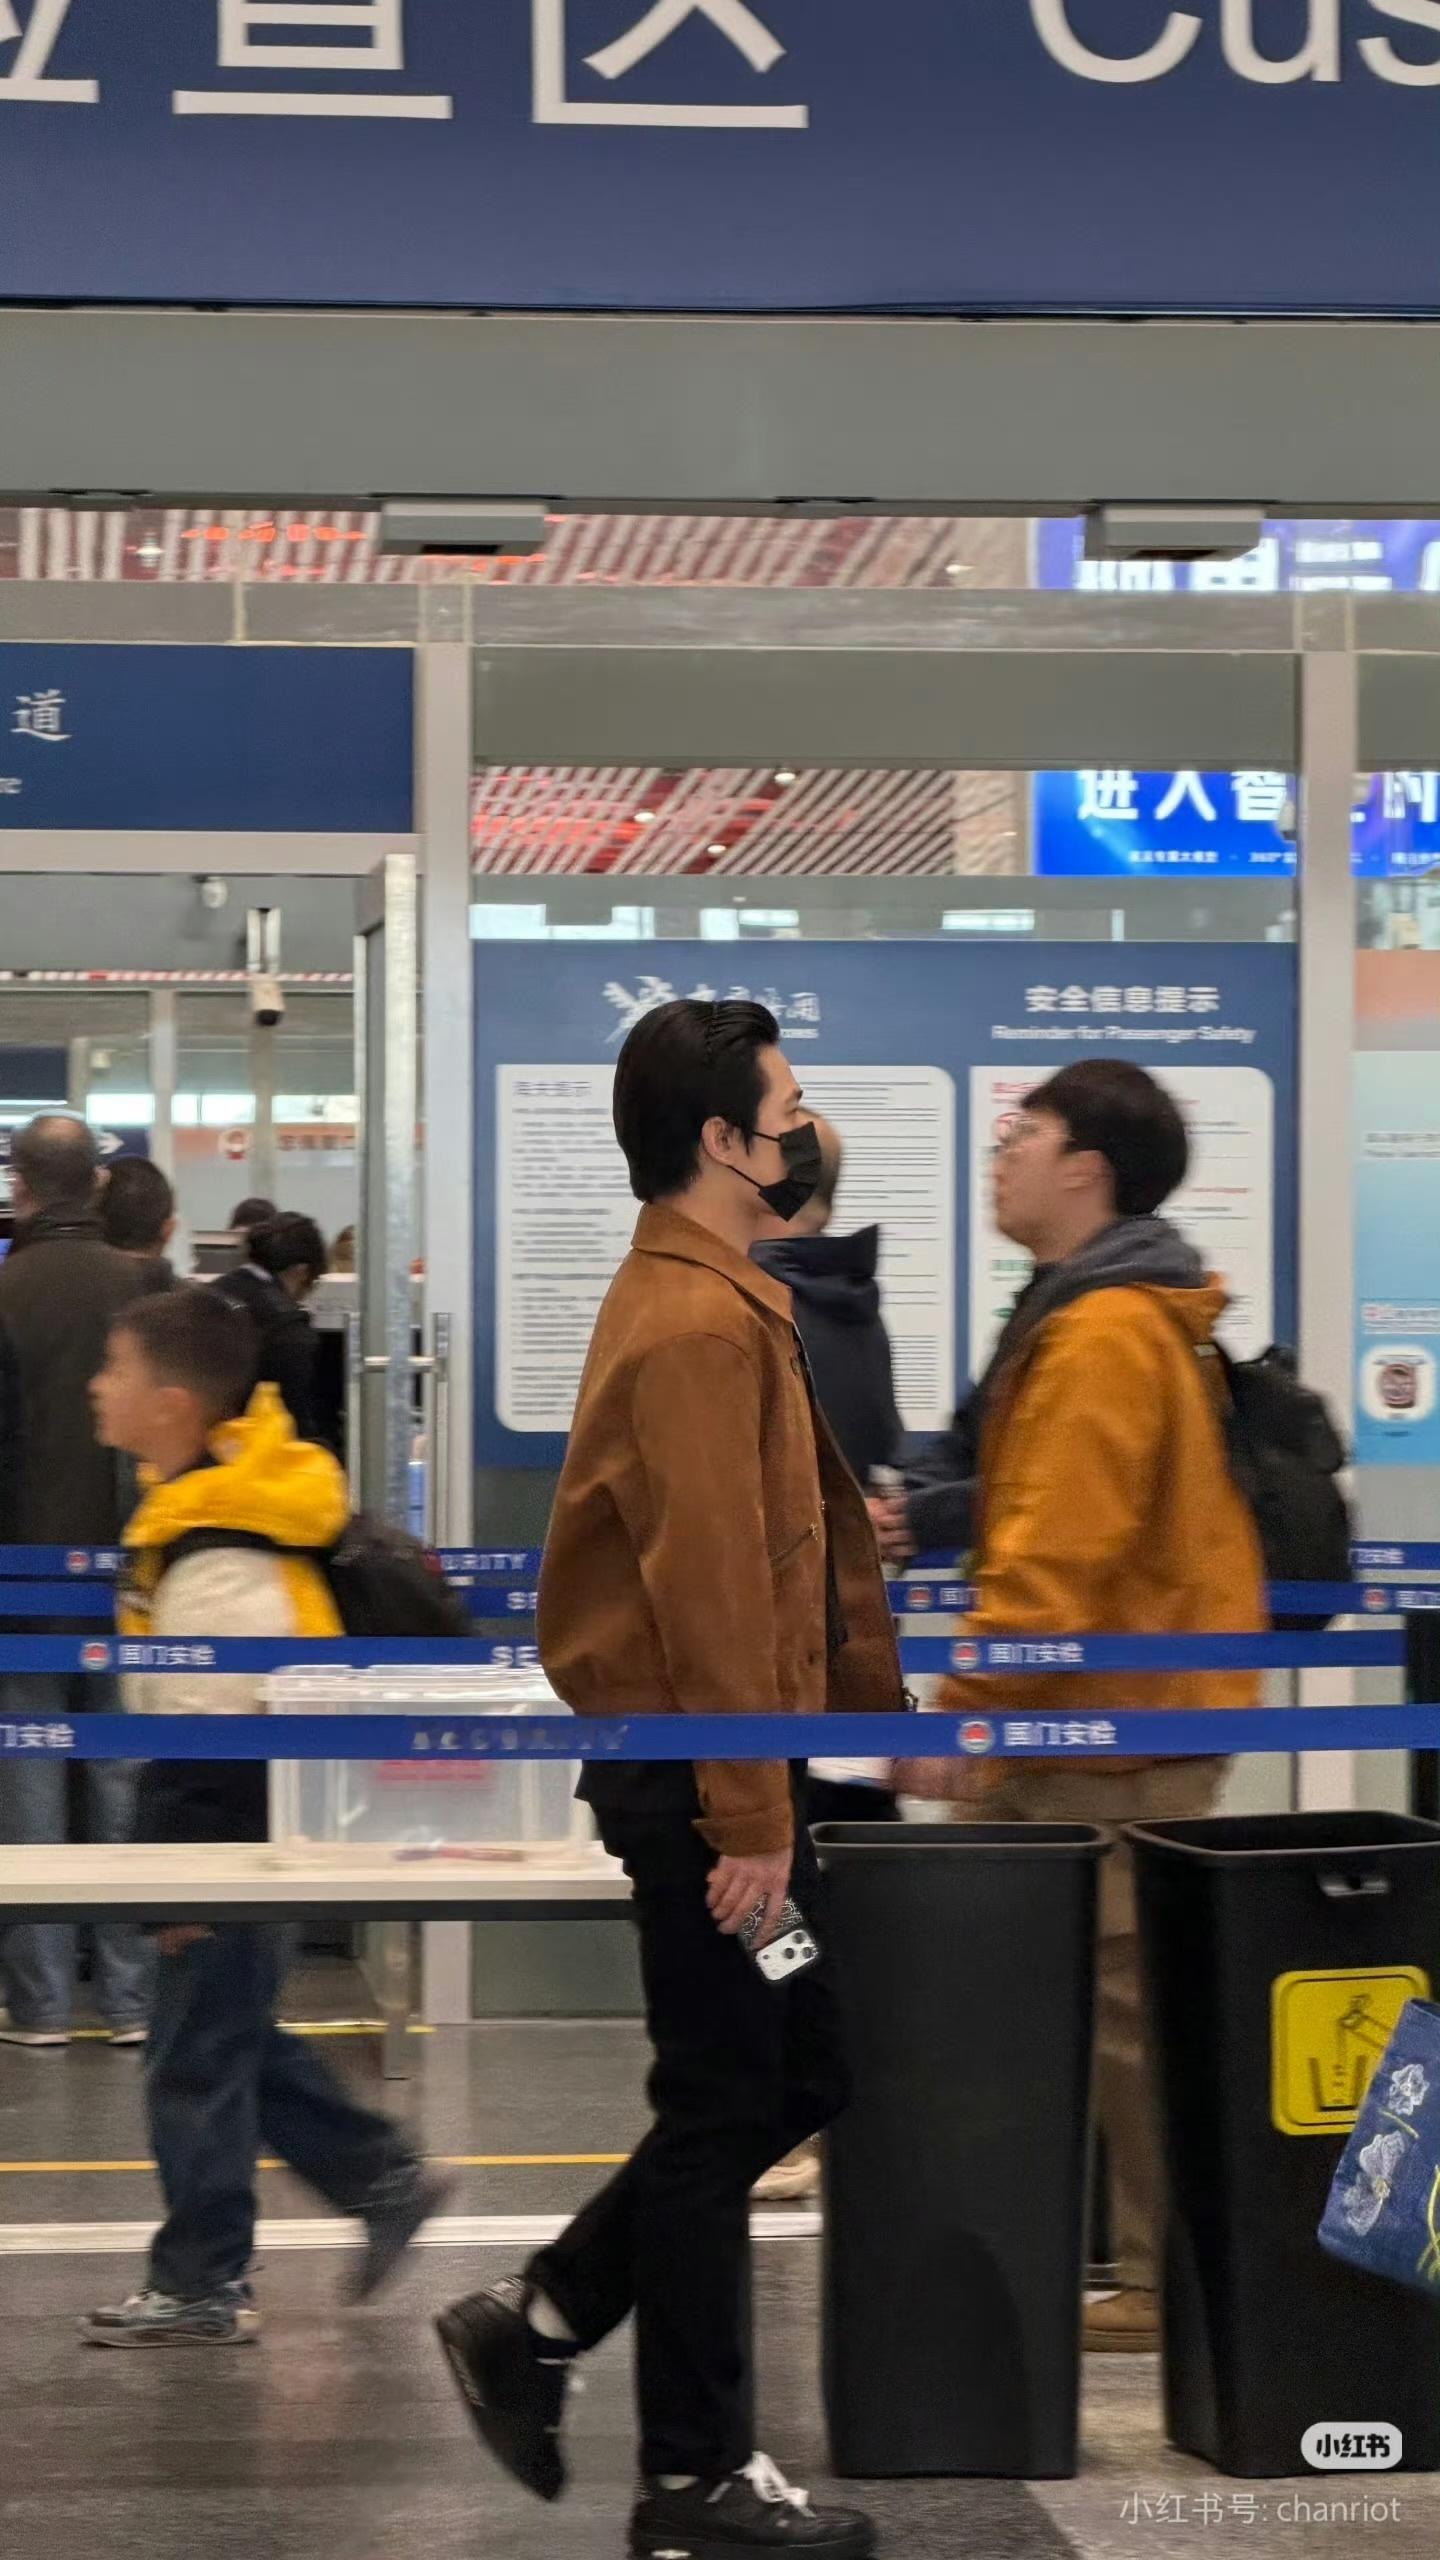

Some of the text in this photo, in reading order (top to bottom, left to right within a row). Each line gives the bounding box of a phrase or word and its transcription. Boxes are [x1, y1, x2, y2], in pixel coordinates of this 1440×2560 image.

[10, 688, 72, 741] 道
[1025, 985, 1220, 1012] 安全信息提示
[118, 1643, 217, 1666] 国门安检
[987, 1641, 1085, 1665] 国门安检
[1004, 1719, 1118, 1747] 国门安检
